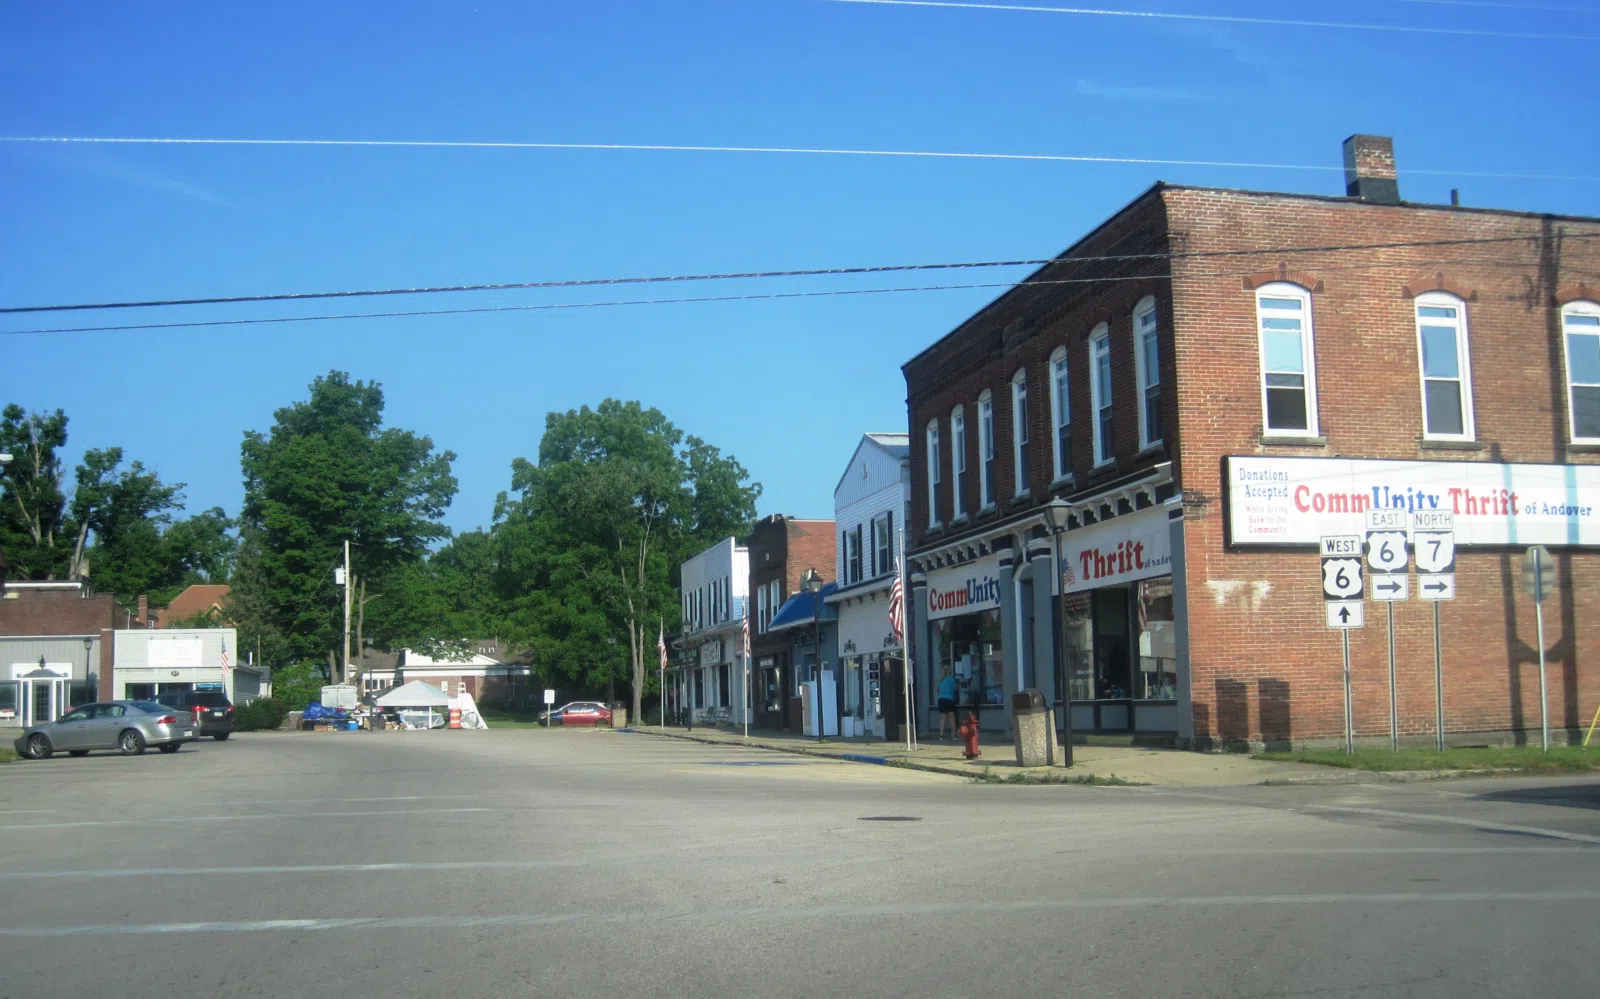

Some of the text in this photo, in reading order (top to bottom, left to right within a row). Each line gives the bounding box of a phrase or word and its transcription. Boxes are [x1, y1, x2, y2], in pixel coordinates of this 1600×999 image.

[1239, 467, 1289, 481] Donations
[1244, 484, 1289, 500] Accepted
[1245, 504, 1289, 514] While Giving
[1448, 487, 1519, 516] Thrift
[1525, 502, 1537, 515] of
[1541, 502, 1592, 516] Andover
[1248, 515, 1287, 524] Back to the
[1372, 513, 1399, 526] EAST
[1415, 514, 1451, 526] NORTH
[1248, 526, 1288, 535] Community
[1326, 539, 1356, 553] WEST
[1379, 540, 1395, 563] 6
[1427, 540, 1441, 562] 7
[1079, 540, 1144, 581] Thrift
[1335, 566, 1350, 589] 6
[929, 574, 1001, 612] CommUnity
